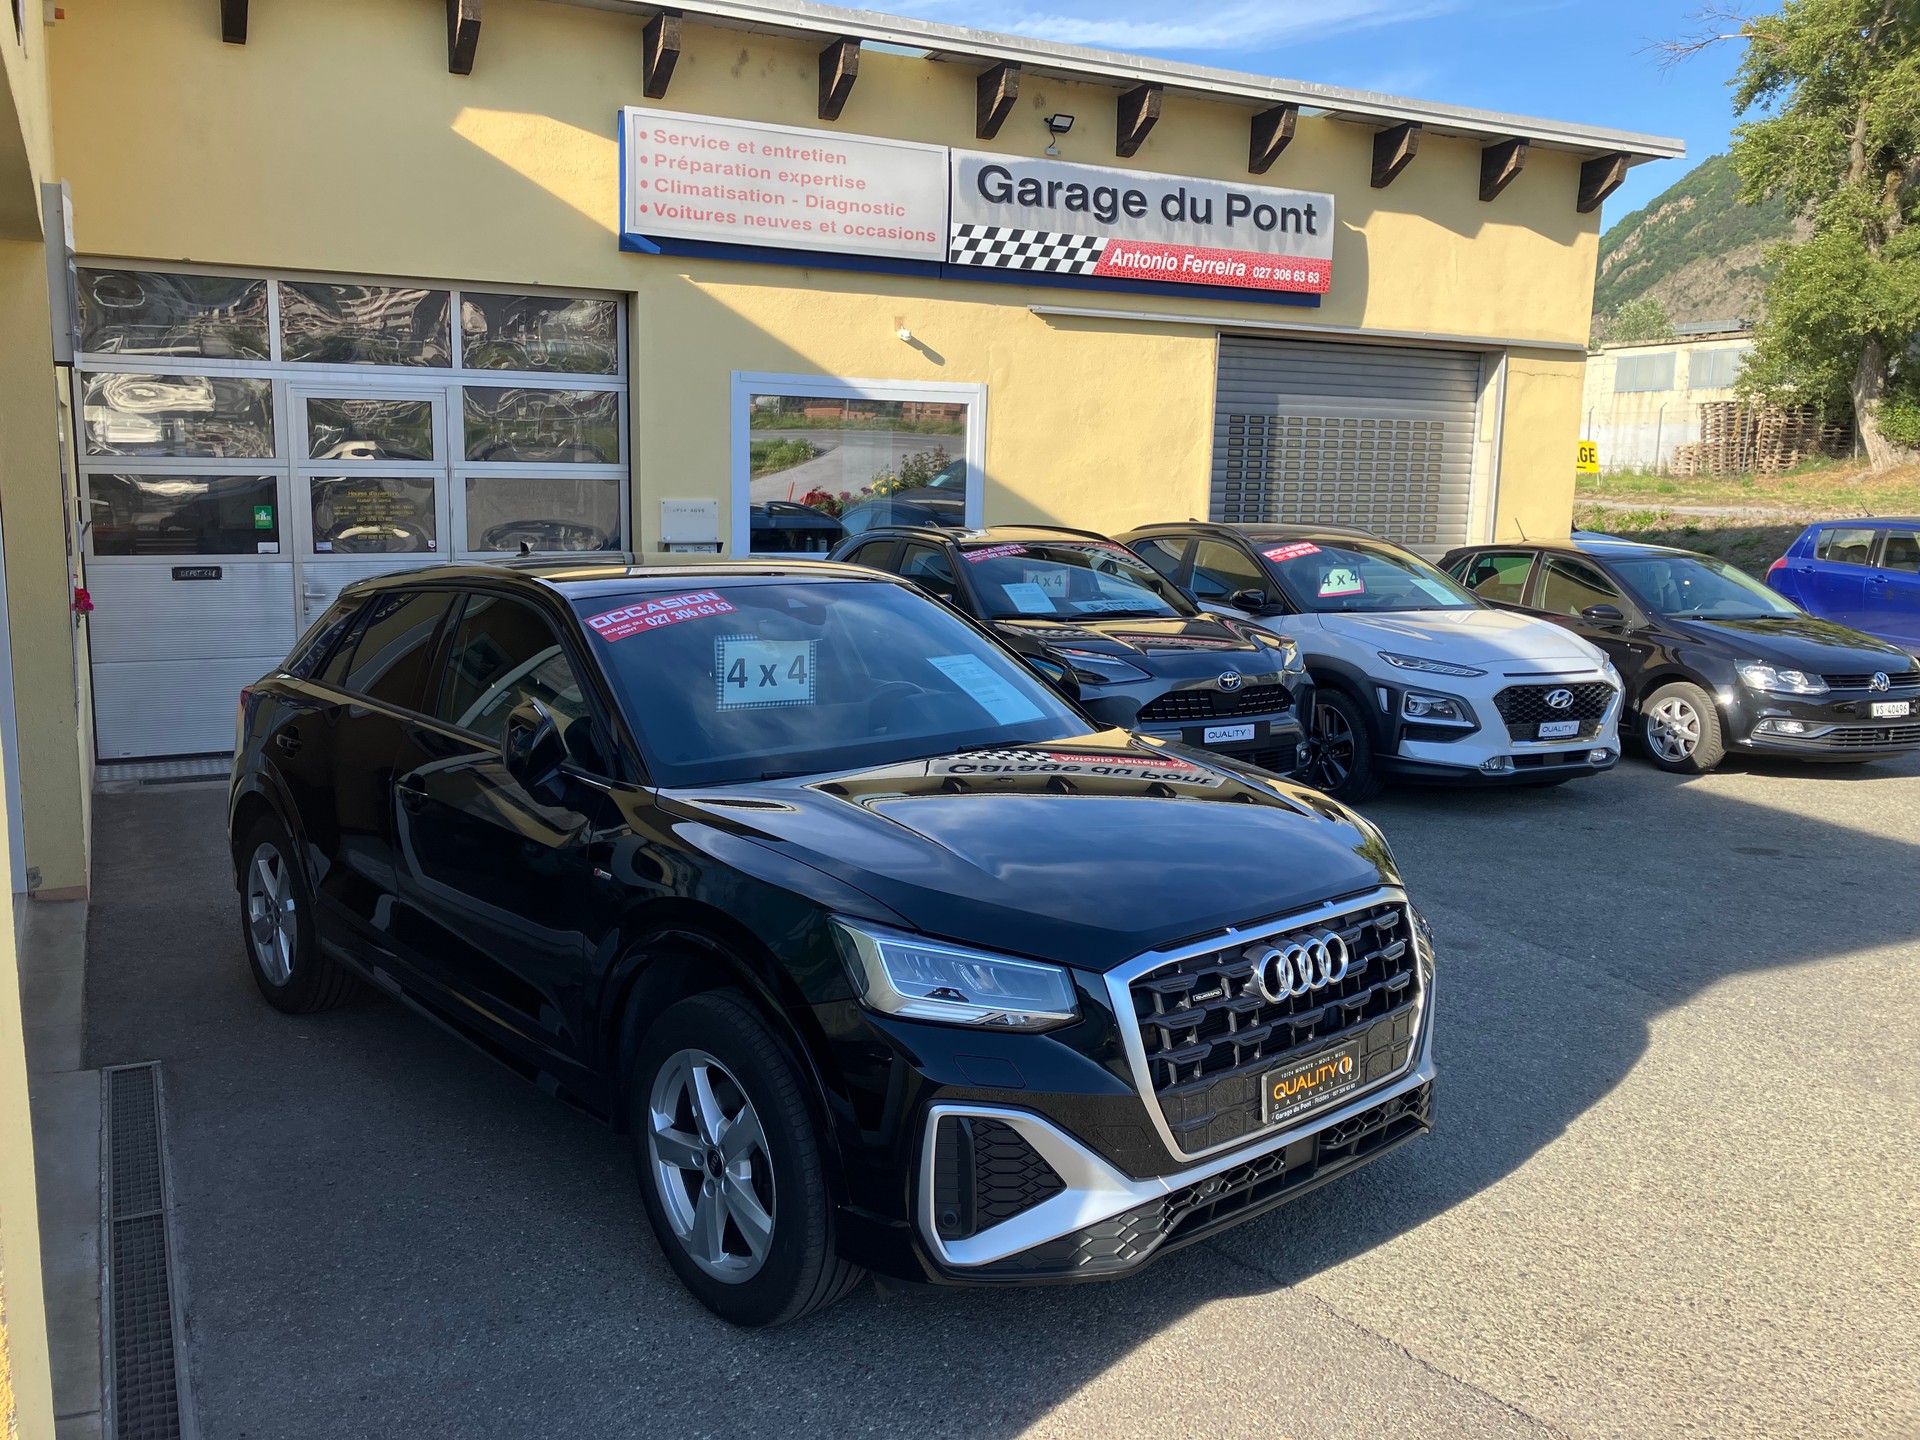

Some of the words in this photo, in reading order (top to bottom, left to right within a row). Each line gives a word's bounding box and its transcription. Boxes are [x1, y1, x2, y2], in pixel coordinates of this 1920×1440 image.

[653, 129, 730, 151] Service
[737, 141, 755, 155] et
[762, 144, 847, 165] entretien
[653, 153, 771, 180] Préparation
[778, 170, 867, 190] expertise
[653, 178, 785, 205] Climatisation
[805, 194, 906, 217] Diagnostic
[977, 164, 1148, 224] Garage
[1161, 187, 1213, 225] du
[1226, 193, 1318, 235] Pont
[653, 202, 737, 224] Voitures
[743, 213, 812, 231] neuves
[819, 220, 837, 234] et
[843, 224, 936, 243] occasions
[1109, 247, 1178, 271] Antonio
[1182, 254, 1246, 277] Ferreira
[1252, 266, 1271, 279] 027
[1273, 267, 1292, 281] 306
[1293, 269, 1306, 282] 63
[1307, 271, 1320, 284] 63
[1577, 447, 1596, 463] GE
[962, 544, 1021, 559] OCCASION
[1043, 577, 1051, 587] x
[1054, 574, 1062, 587] 4
[1321, 572, 1332, 587] 4
[1336, 574, 1346, 586] x
[1350, 570, 1359, 584] 4
[588, 592, 721, 629] OCCASION
[645, 613, 672, 627] 027
[670, 607, 698, 620] 306
[698, 605, 714, 615] 63
[715, 602, 733, 611] 63
[601, 623, 632, 636] GARAGE
[632, 619, 643, 627] DU
[618, 626, 638, 636] PONT
[727, 658, 748, 688] 4
[758, 663, 778, 688] x
[787, 655, 808, 685] 4
[1875, 704, 1884, 715] VS
[1887, 704, 1908, 715] 40496
[1273, 1062, 1338, 1100] QUALITY
[1275, 1108, 1293, 1120] Garage
